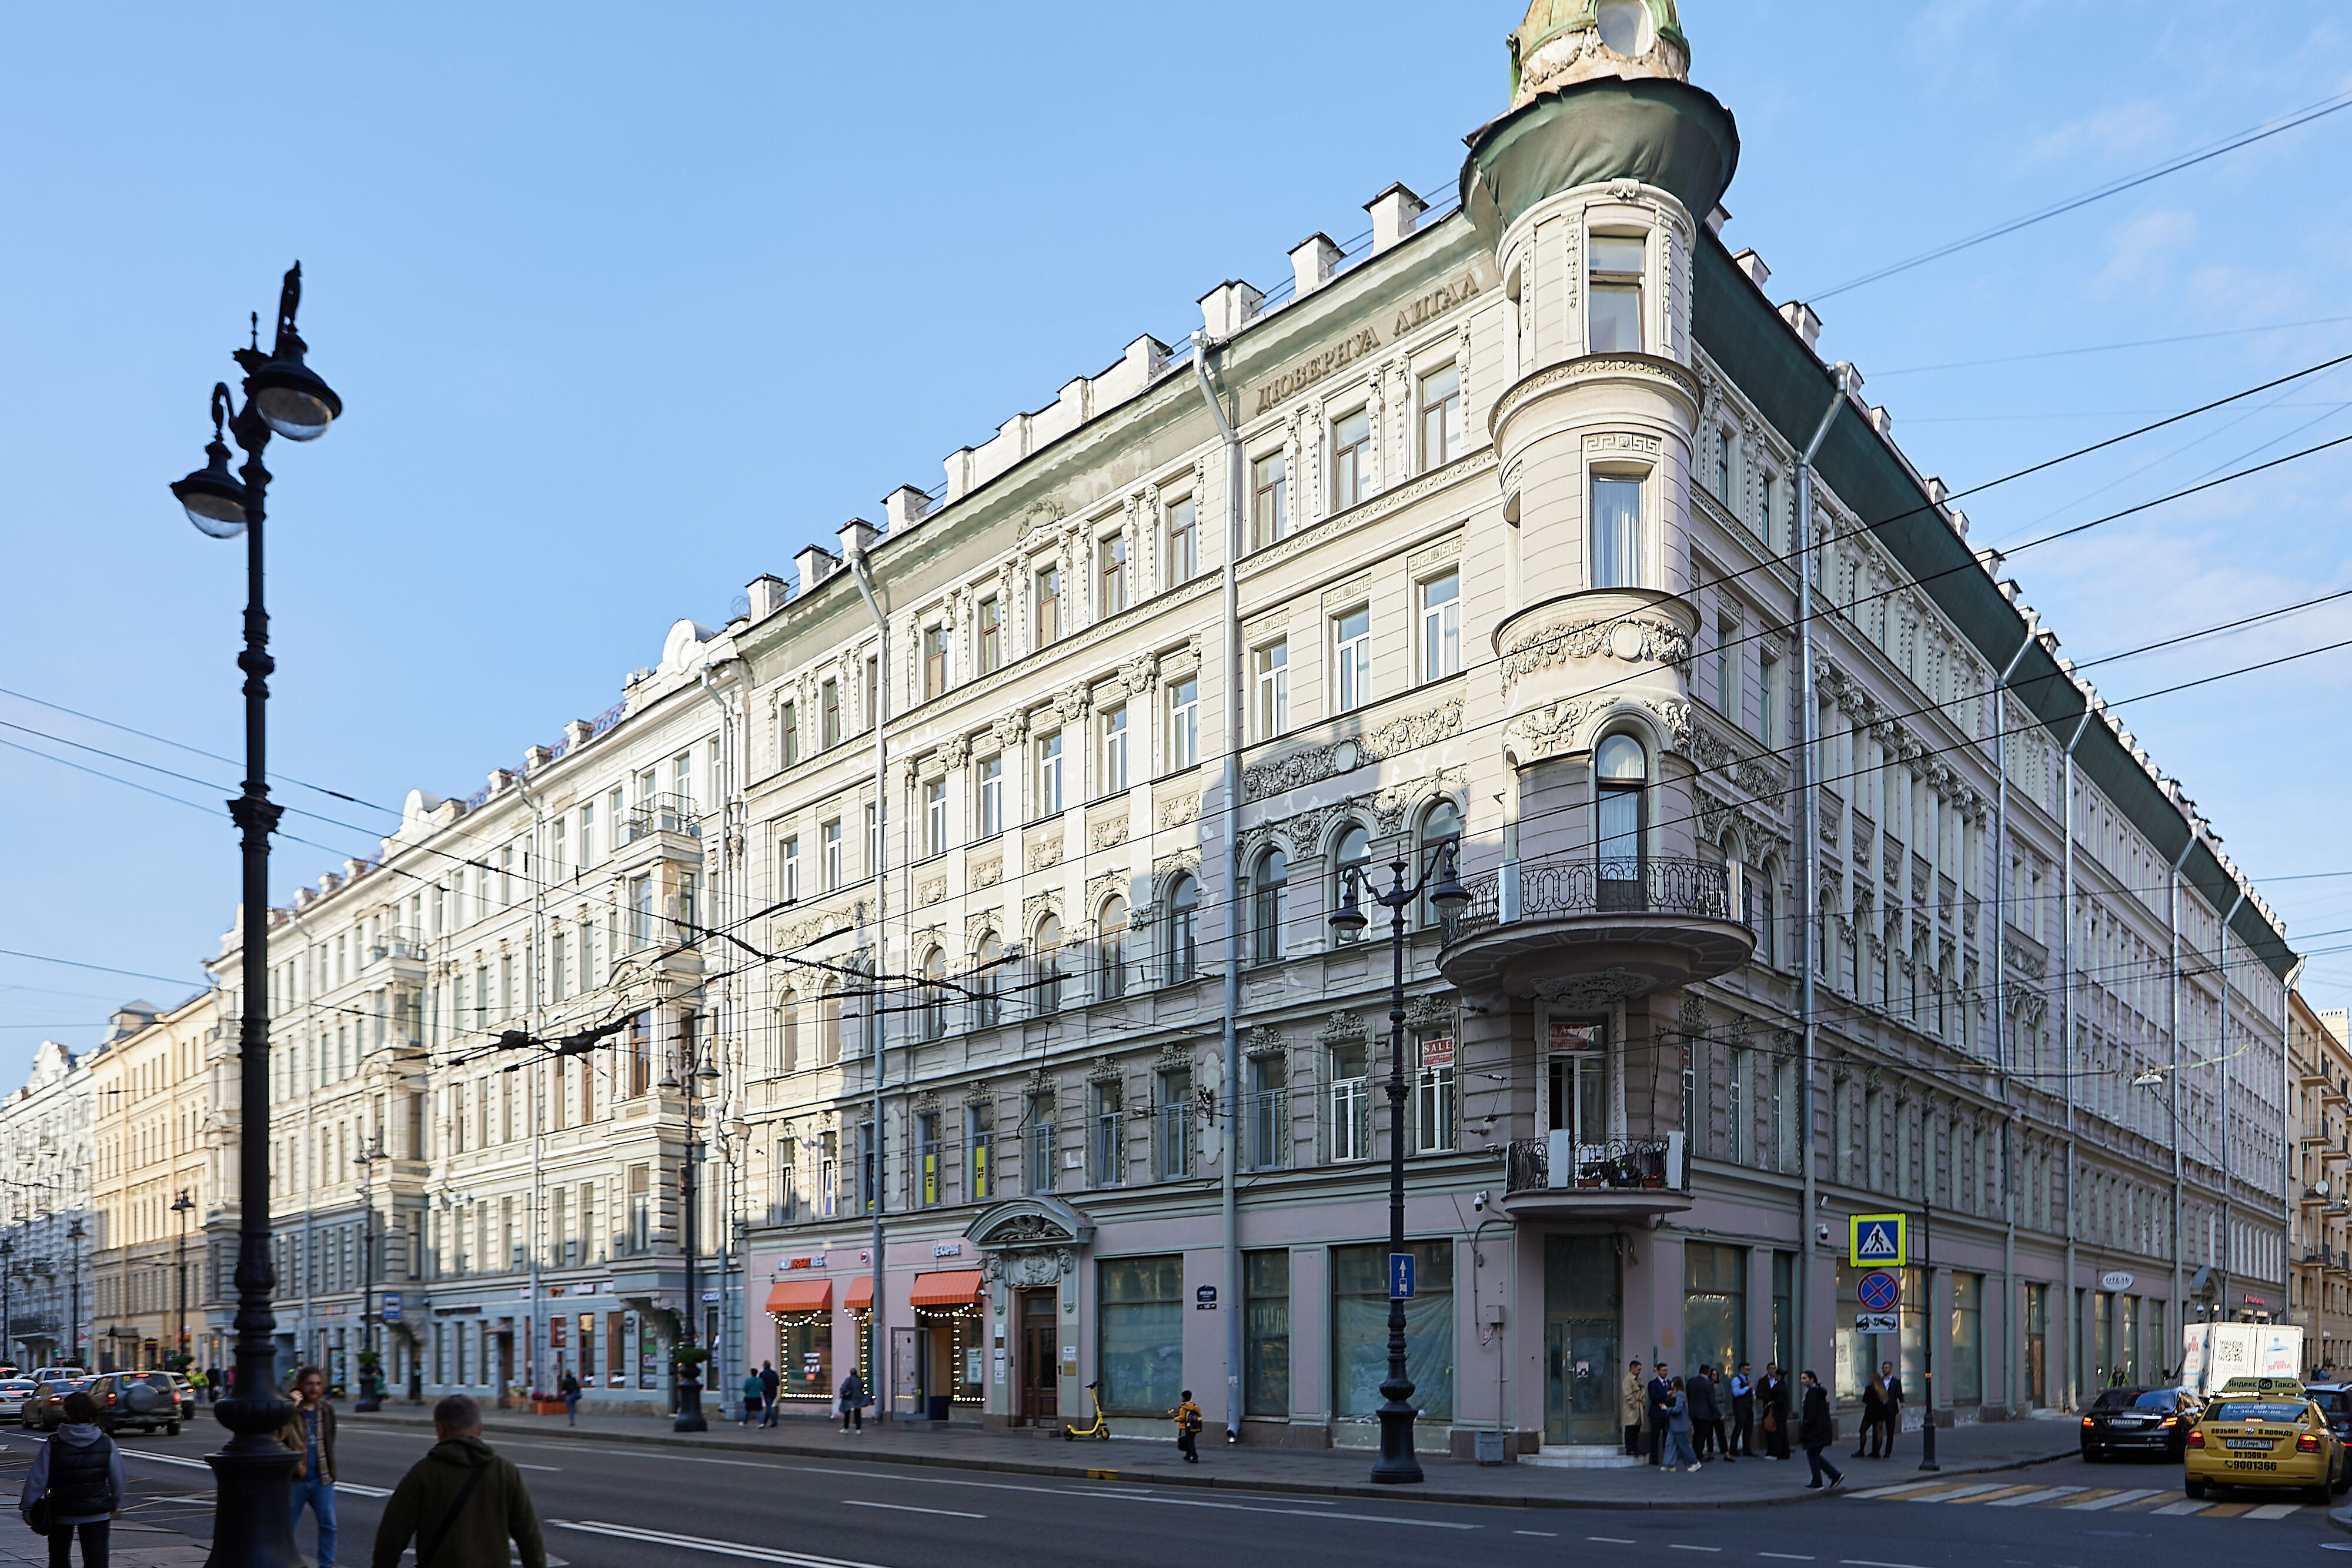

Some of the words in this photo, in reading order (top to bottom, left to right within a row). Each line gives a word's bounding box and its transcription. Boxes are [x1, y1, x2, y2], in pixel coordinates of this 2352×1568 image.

[1255, 326, 1381, 416] ДЮВЕРНУА
[1392, 272, 1479, 337] ЛИГАЛ
[1424, 1040, 1451, 1054] SALE
[2229, 1380, 2257, 1388] Яндекс
[2260, 1380, 2272, 1389] Go
[2233, 1460, 2277, 1471] 9001366
